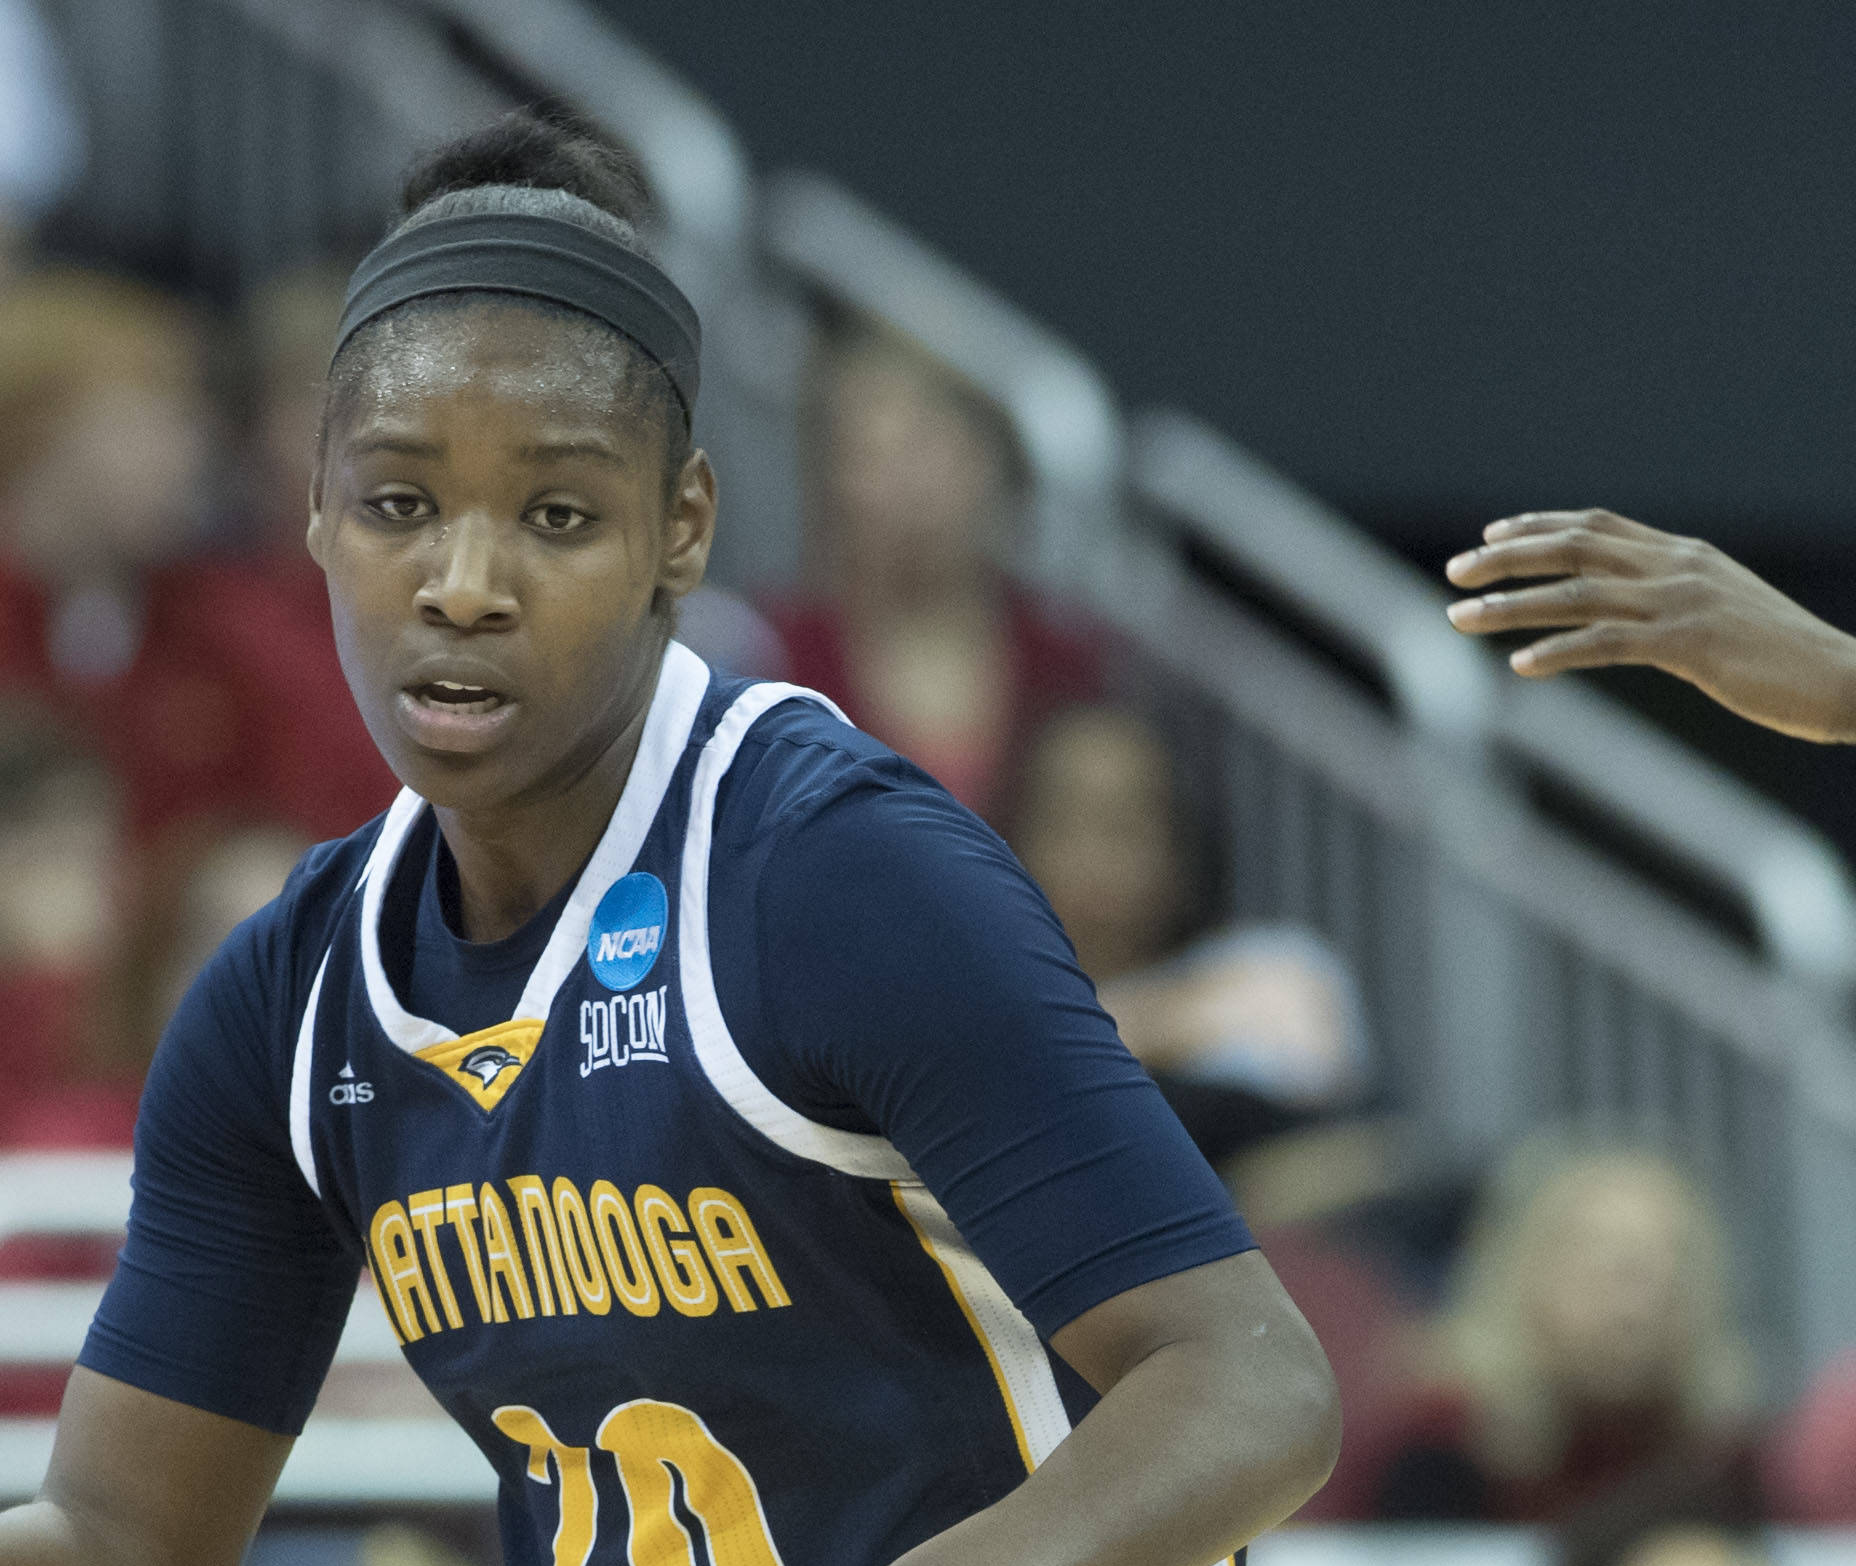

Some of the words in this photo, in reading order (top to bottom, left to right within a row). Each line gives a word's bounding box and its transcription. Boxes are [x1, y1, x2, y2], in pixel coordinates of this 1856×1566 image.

[596, 926, 661, 962] NCAA
[580, 985, 669, 1078] SOCON
[363, 1174, 792, 1346] ATTANOOGA
